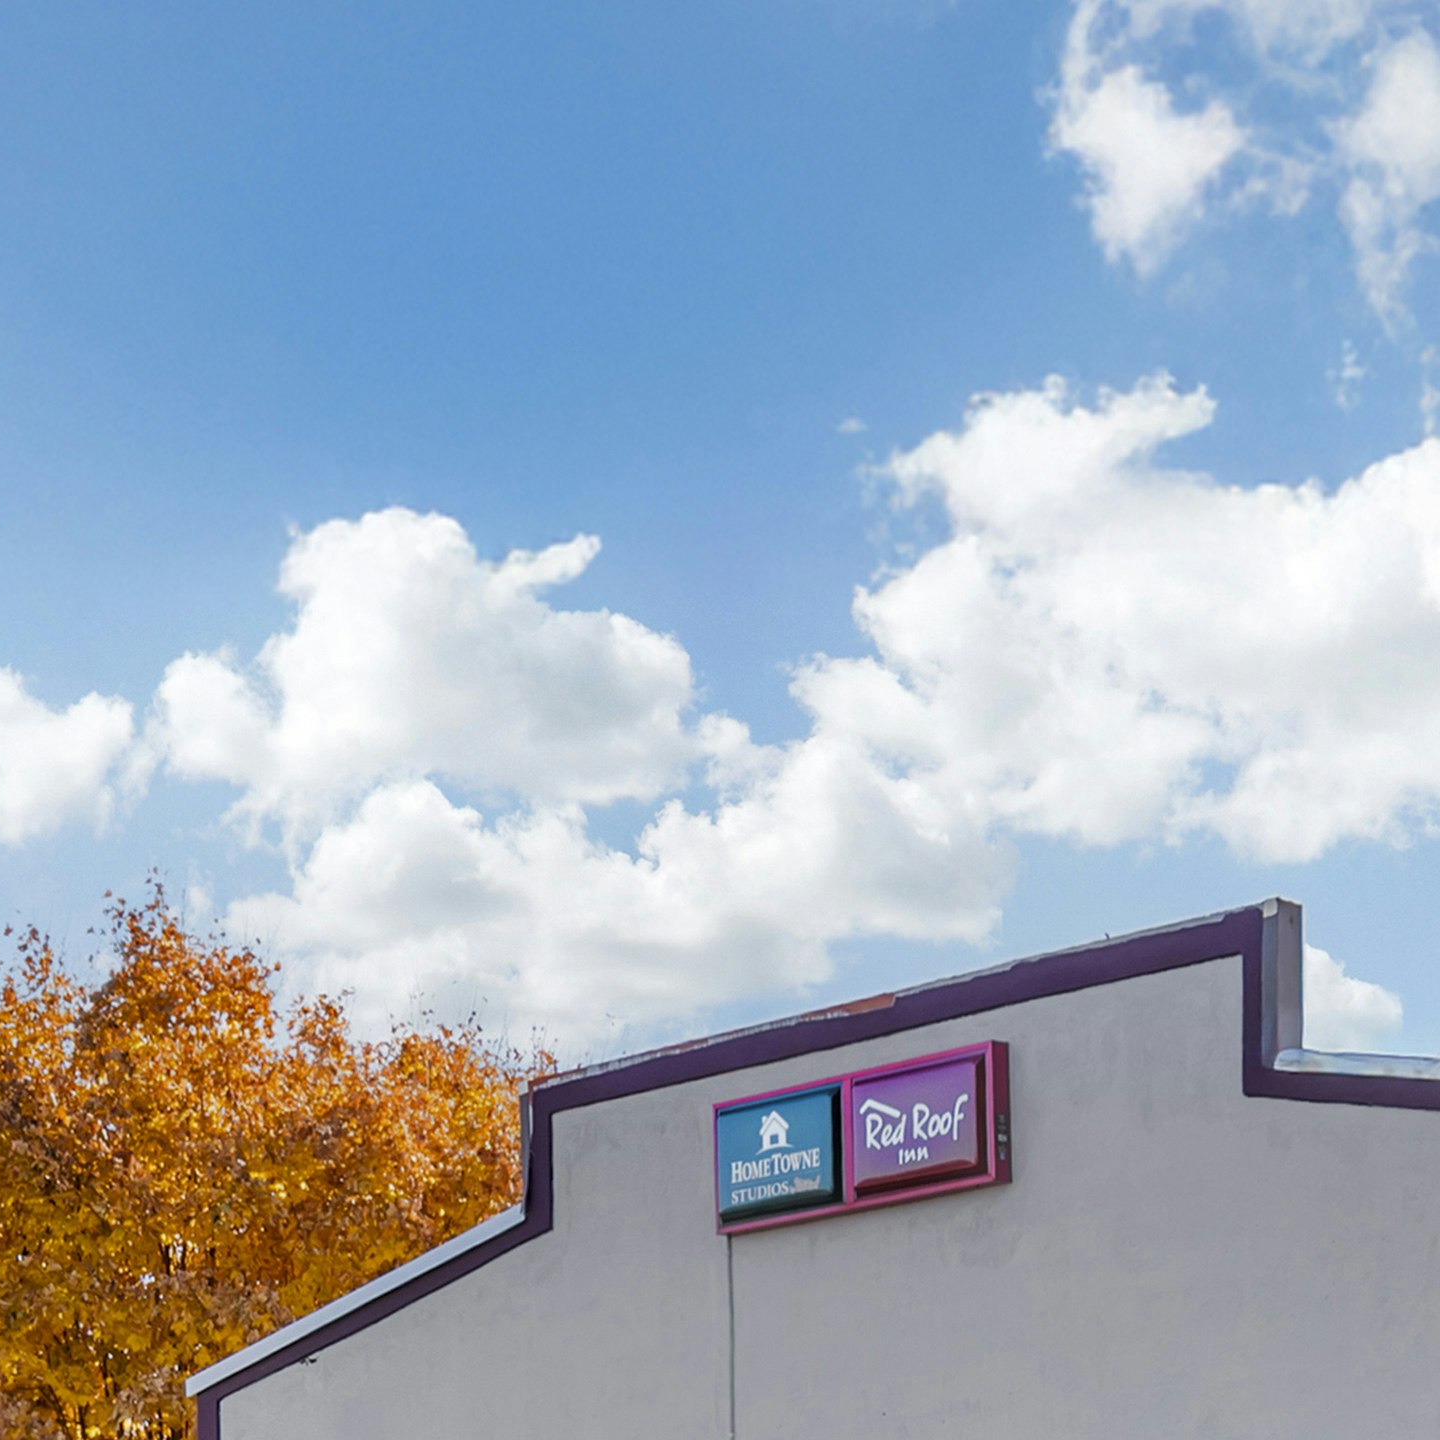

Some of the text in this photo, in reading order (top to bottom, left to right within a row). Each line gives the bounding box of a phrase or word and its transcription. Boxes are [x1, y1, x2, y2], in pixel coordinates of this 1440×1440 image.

[866, 1113, 907, 1150] Red
[912, 1094, 968, 1141] Roof
[731, 1180, 789, 1205] STUDIOS
